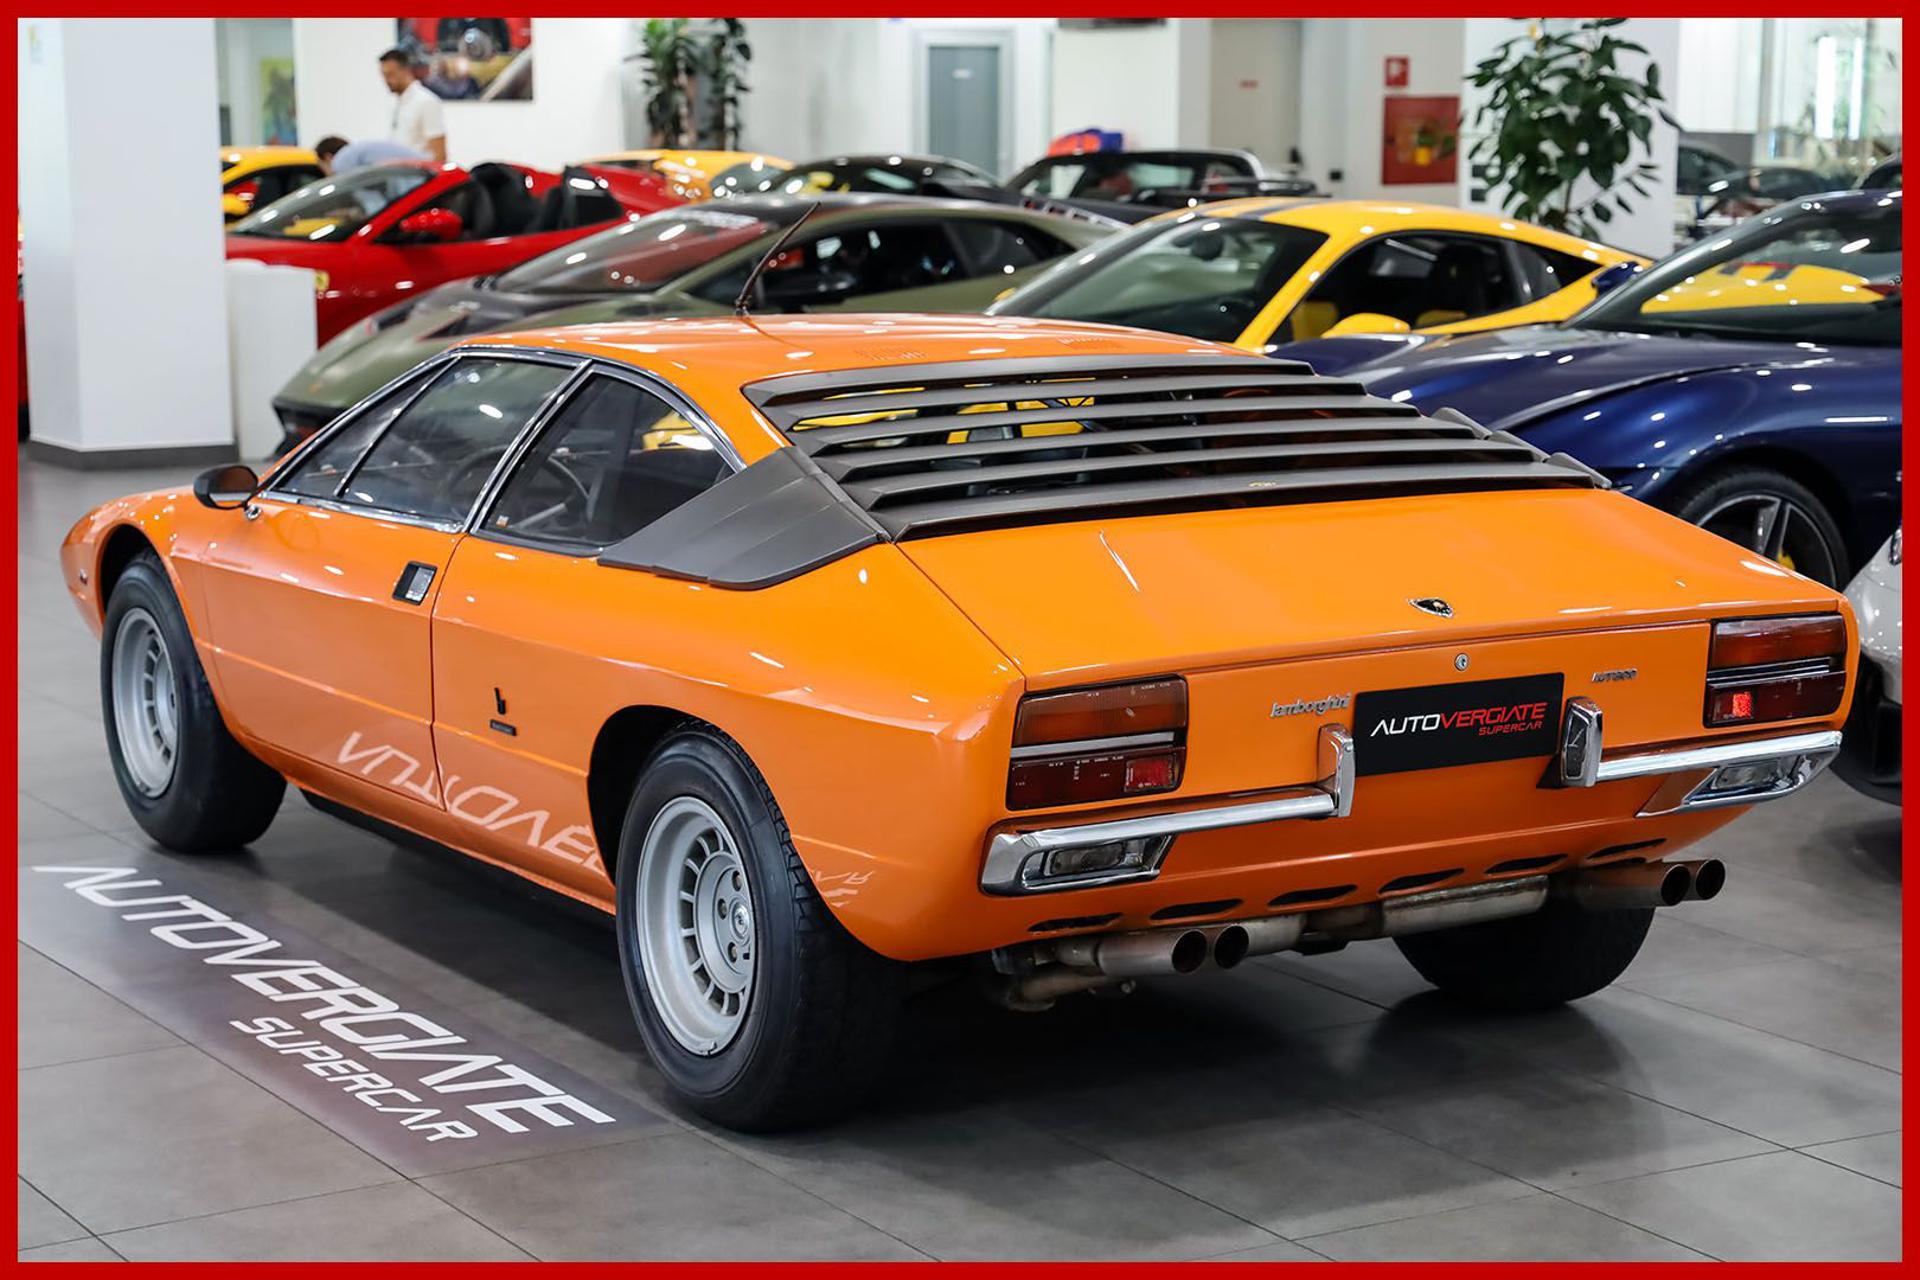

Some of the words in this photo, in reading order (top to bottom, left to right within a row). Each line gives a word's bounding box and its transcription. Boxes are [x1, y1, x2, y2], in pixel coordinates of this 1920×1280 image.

[1370, 702, 1548, 737] AUTOVERGIATE
[1478, 720, 1543, 736] SUPERCAR
[31, 865, 617, 1134] AUTOVERGIATE
[229, 1016, 479, 1142] SUPERCAR
